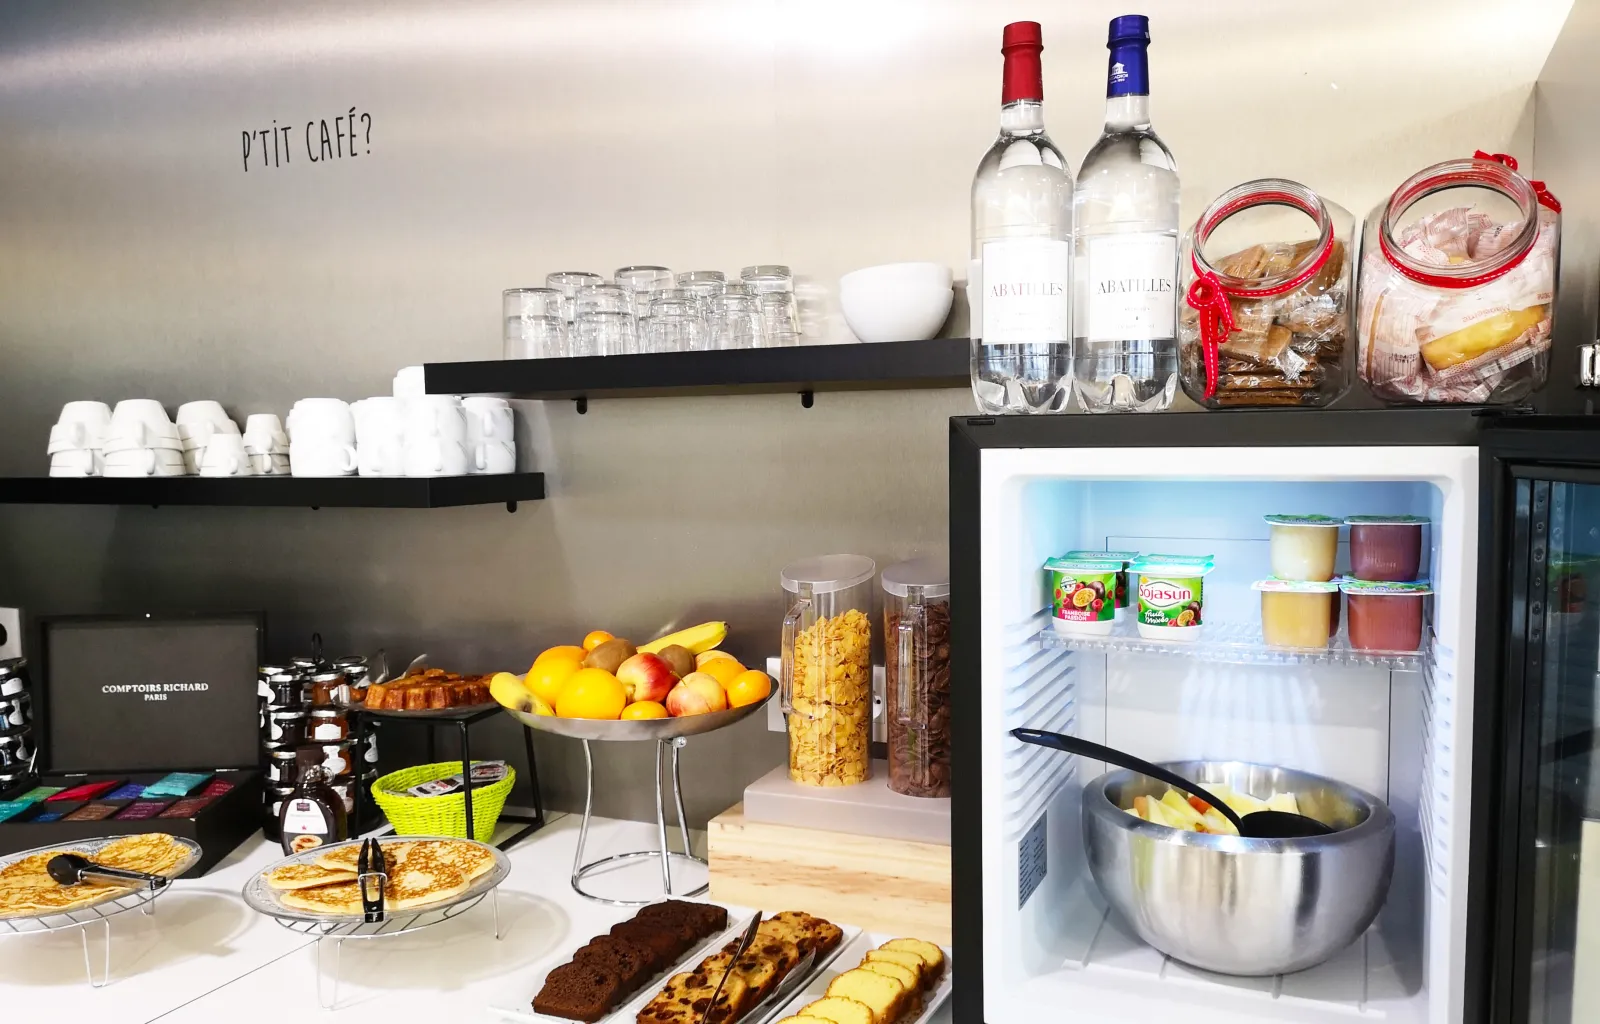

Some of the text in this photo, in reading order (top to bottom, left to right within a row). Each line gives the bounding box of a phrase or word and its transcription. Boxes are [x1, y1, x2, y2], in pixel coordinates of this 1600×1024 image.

[305, 106, 372, 162] CAFÉ?
[990, 282, 1064, 298] ABATILLES
[1098, 278, 1172, 294] ABATILLES
[1139, 584, 1191, 601] Sojasun
[102, 683, 209, 693] COMPTOIRS RICHARD
[144, 693, 167, 701] PARIS
